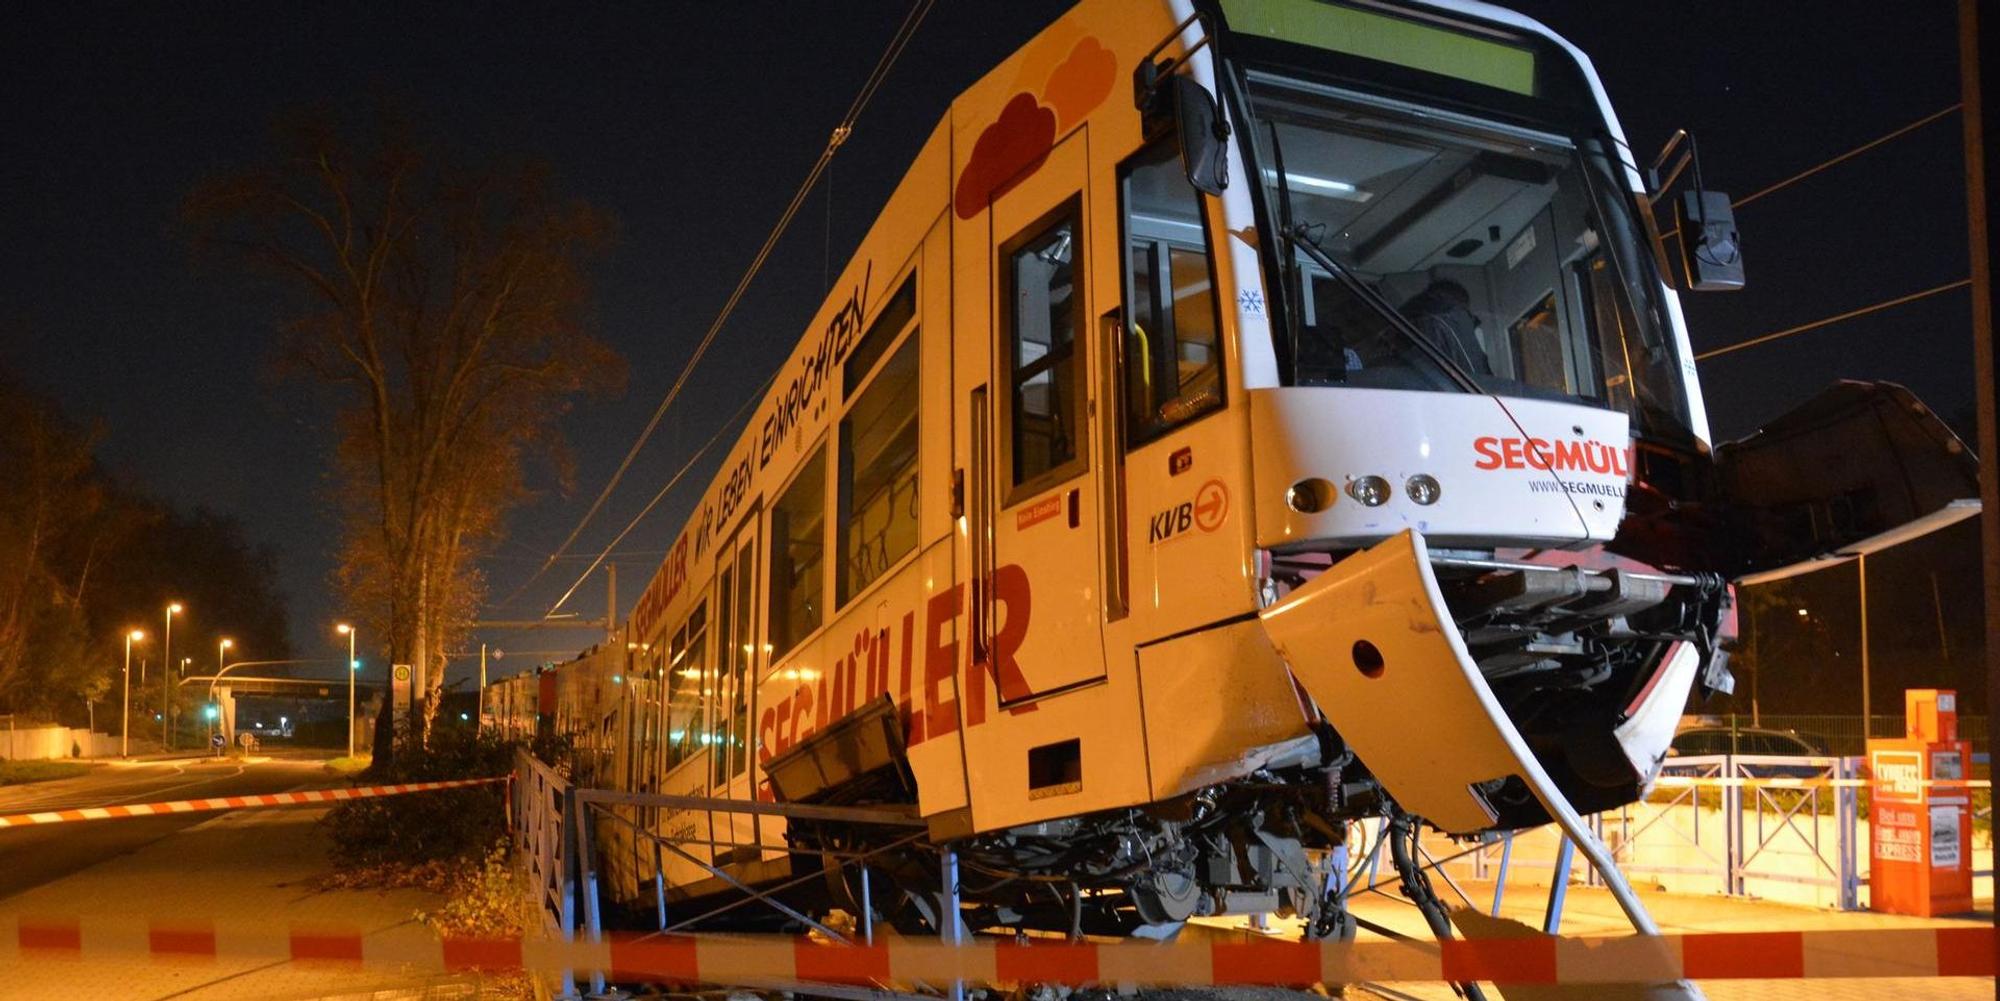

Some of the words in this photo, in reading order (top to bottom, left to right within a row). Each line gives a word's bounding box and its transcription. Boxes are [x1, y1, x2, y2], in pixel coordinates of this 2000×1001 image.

[715, 435, 757, 535] LEBEN
[760, 259, 873, 471] EINRICHTEN
[1149, 501, 1194, 545] KVB
